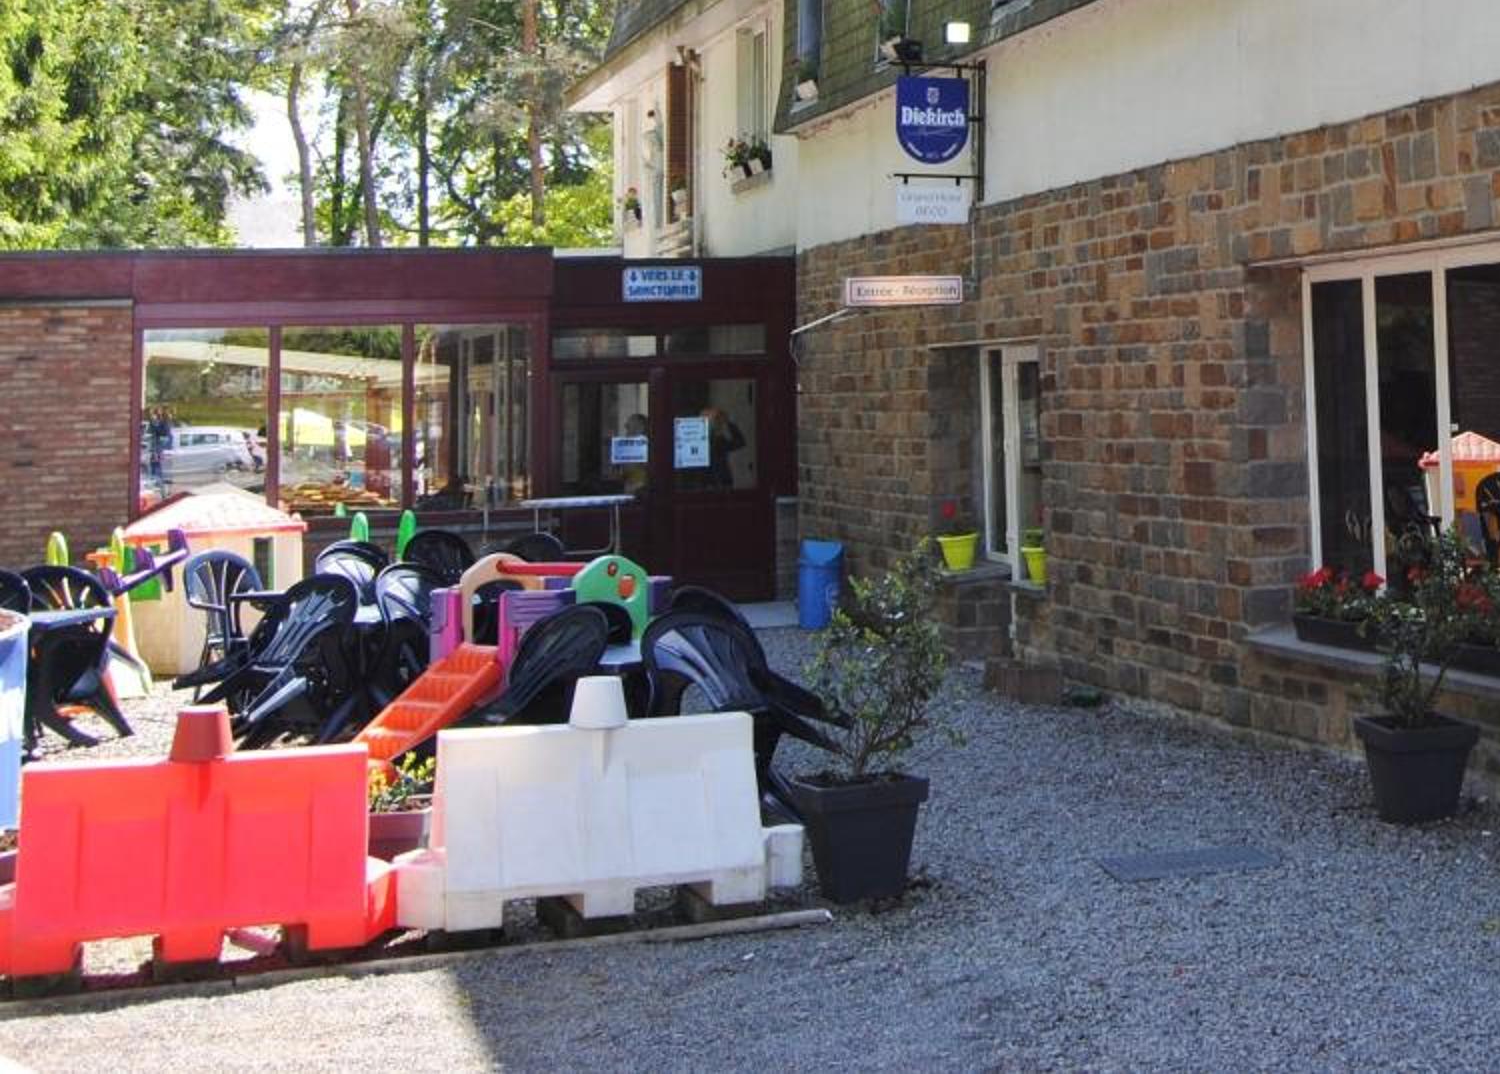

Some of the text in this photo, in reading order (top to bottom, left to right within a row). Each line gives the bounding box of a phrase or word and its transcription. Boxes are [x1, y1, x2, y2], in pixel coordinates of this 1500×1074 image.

[901, 106, 965, 126] Diekirch
[641, 269, 685, 282] VERS LE
